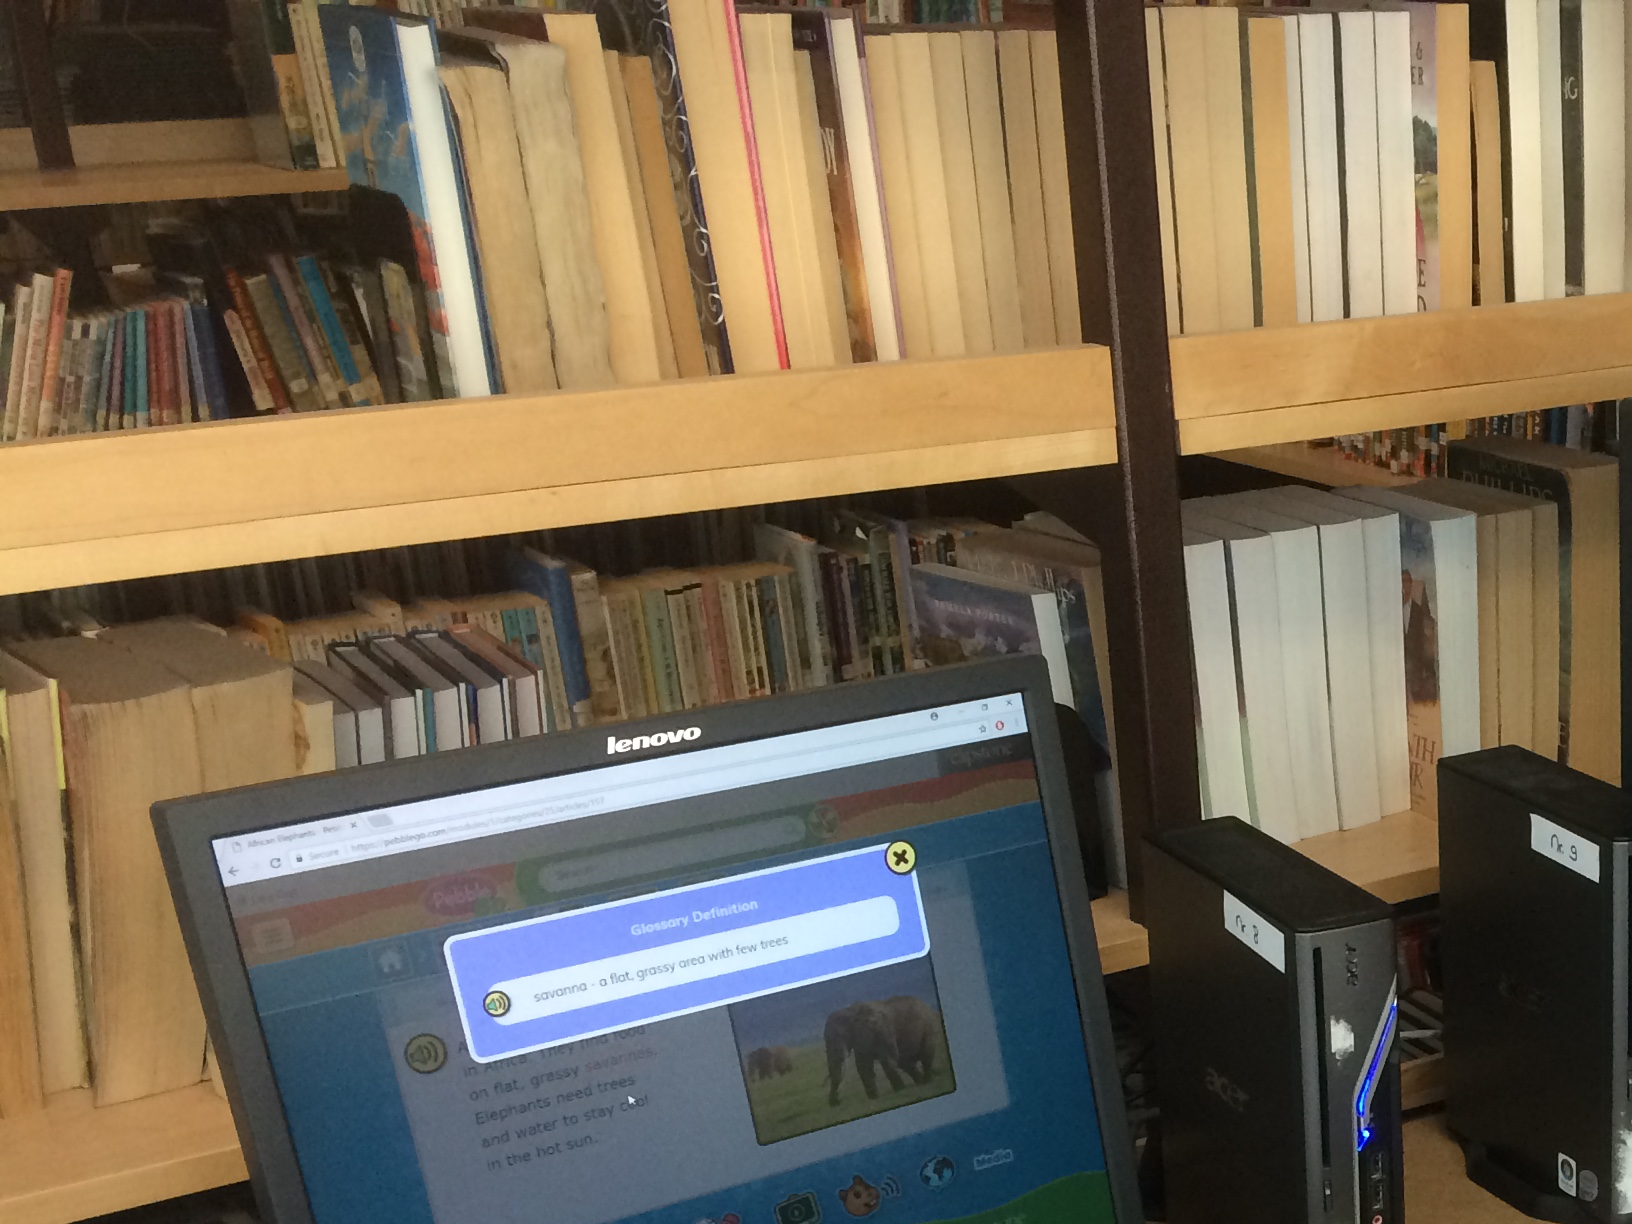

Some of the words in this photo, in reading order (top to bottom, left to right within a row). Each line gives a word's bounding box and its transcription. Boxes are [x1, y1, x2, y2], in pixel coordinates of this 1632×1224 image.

[606, 726, 702, 755] lenovo
[247, 836, 275, 850] African
[276, 828, 316, 845] Elephants
[308, 847, 340, 862] Secure
[1569, 845, 1578, 861] 9
[432, 879, 496, 910] Pebble
[631, 912, 690, 937] Glossary
[692, 899, 759, 923] Definition
[533, 982, 588, 1003] savanna
[599, 977, 608, 988] a
[609, 970, 635, 986] flat,
[637, 960, 676, 981] grassy
[679, 954, 705, 969] area
[708, 946, 734, 962] with
[736, 941, 757, 955] few
[760, 935, 789, 950] trees
[463, 1064, 479, 1078] in
[469, 1088, 490, 1102] on
[494, 1078, 525, 1097] flat,
[530, 1064, 580, 1090] grassy
[584, 1047, 658, 1072] savannas.
[475, 1094, 552, 1126] Elephants
[556, 1085, 593, 1106] need
[596, 1075, 637, 1094] trees
[481, 1128, 511, 1149] and
[515, 1118, 558, 1140] water
[563, 1113, 578, 1126] to
[583, 1102, 615, 1123] stay
[486, 1158, 501, 1172] in
[506, 1147, 532, 1167] the
[536, 1140, 563, 1157] hot
[566, 1133, 598, 1150] sun.
[974, 1149, 1013, 1170] Media
